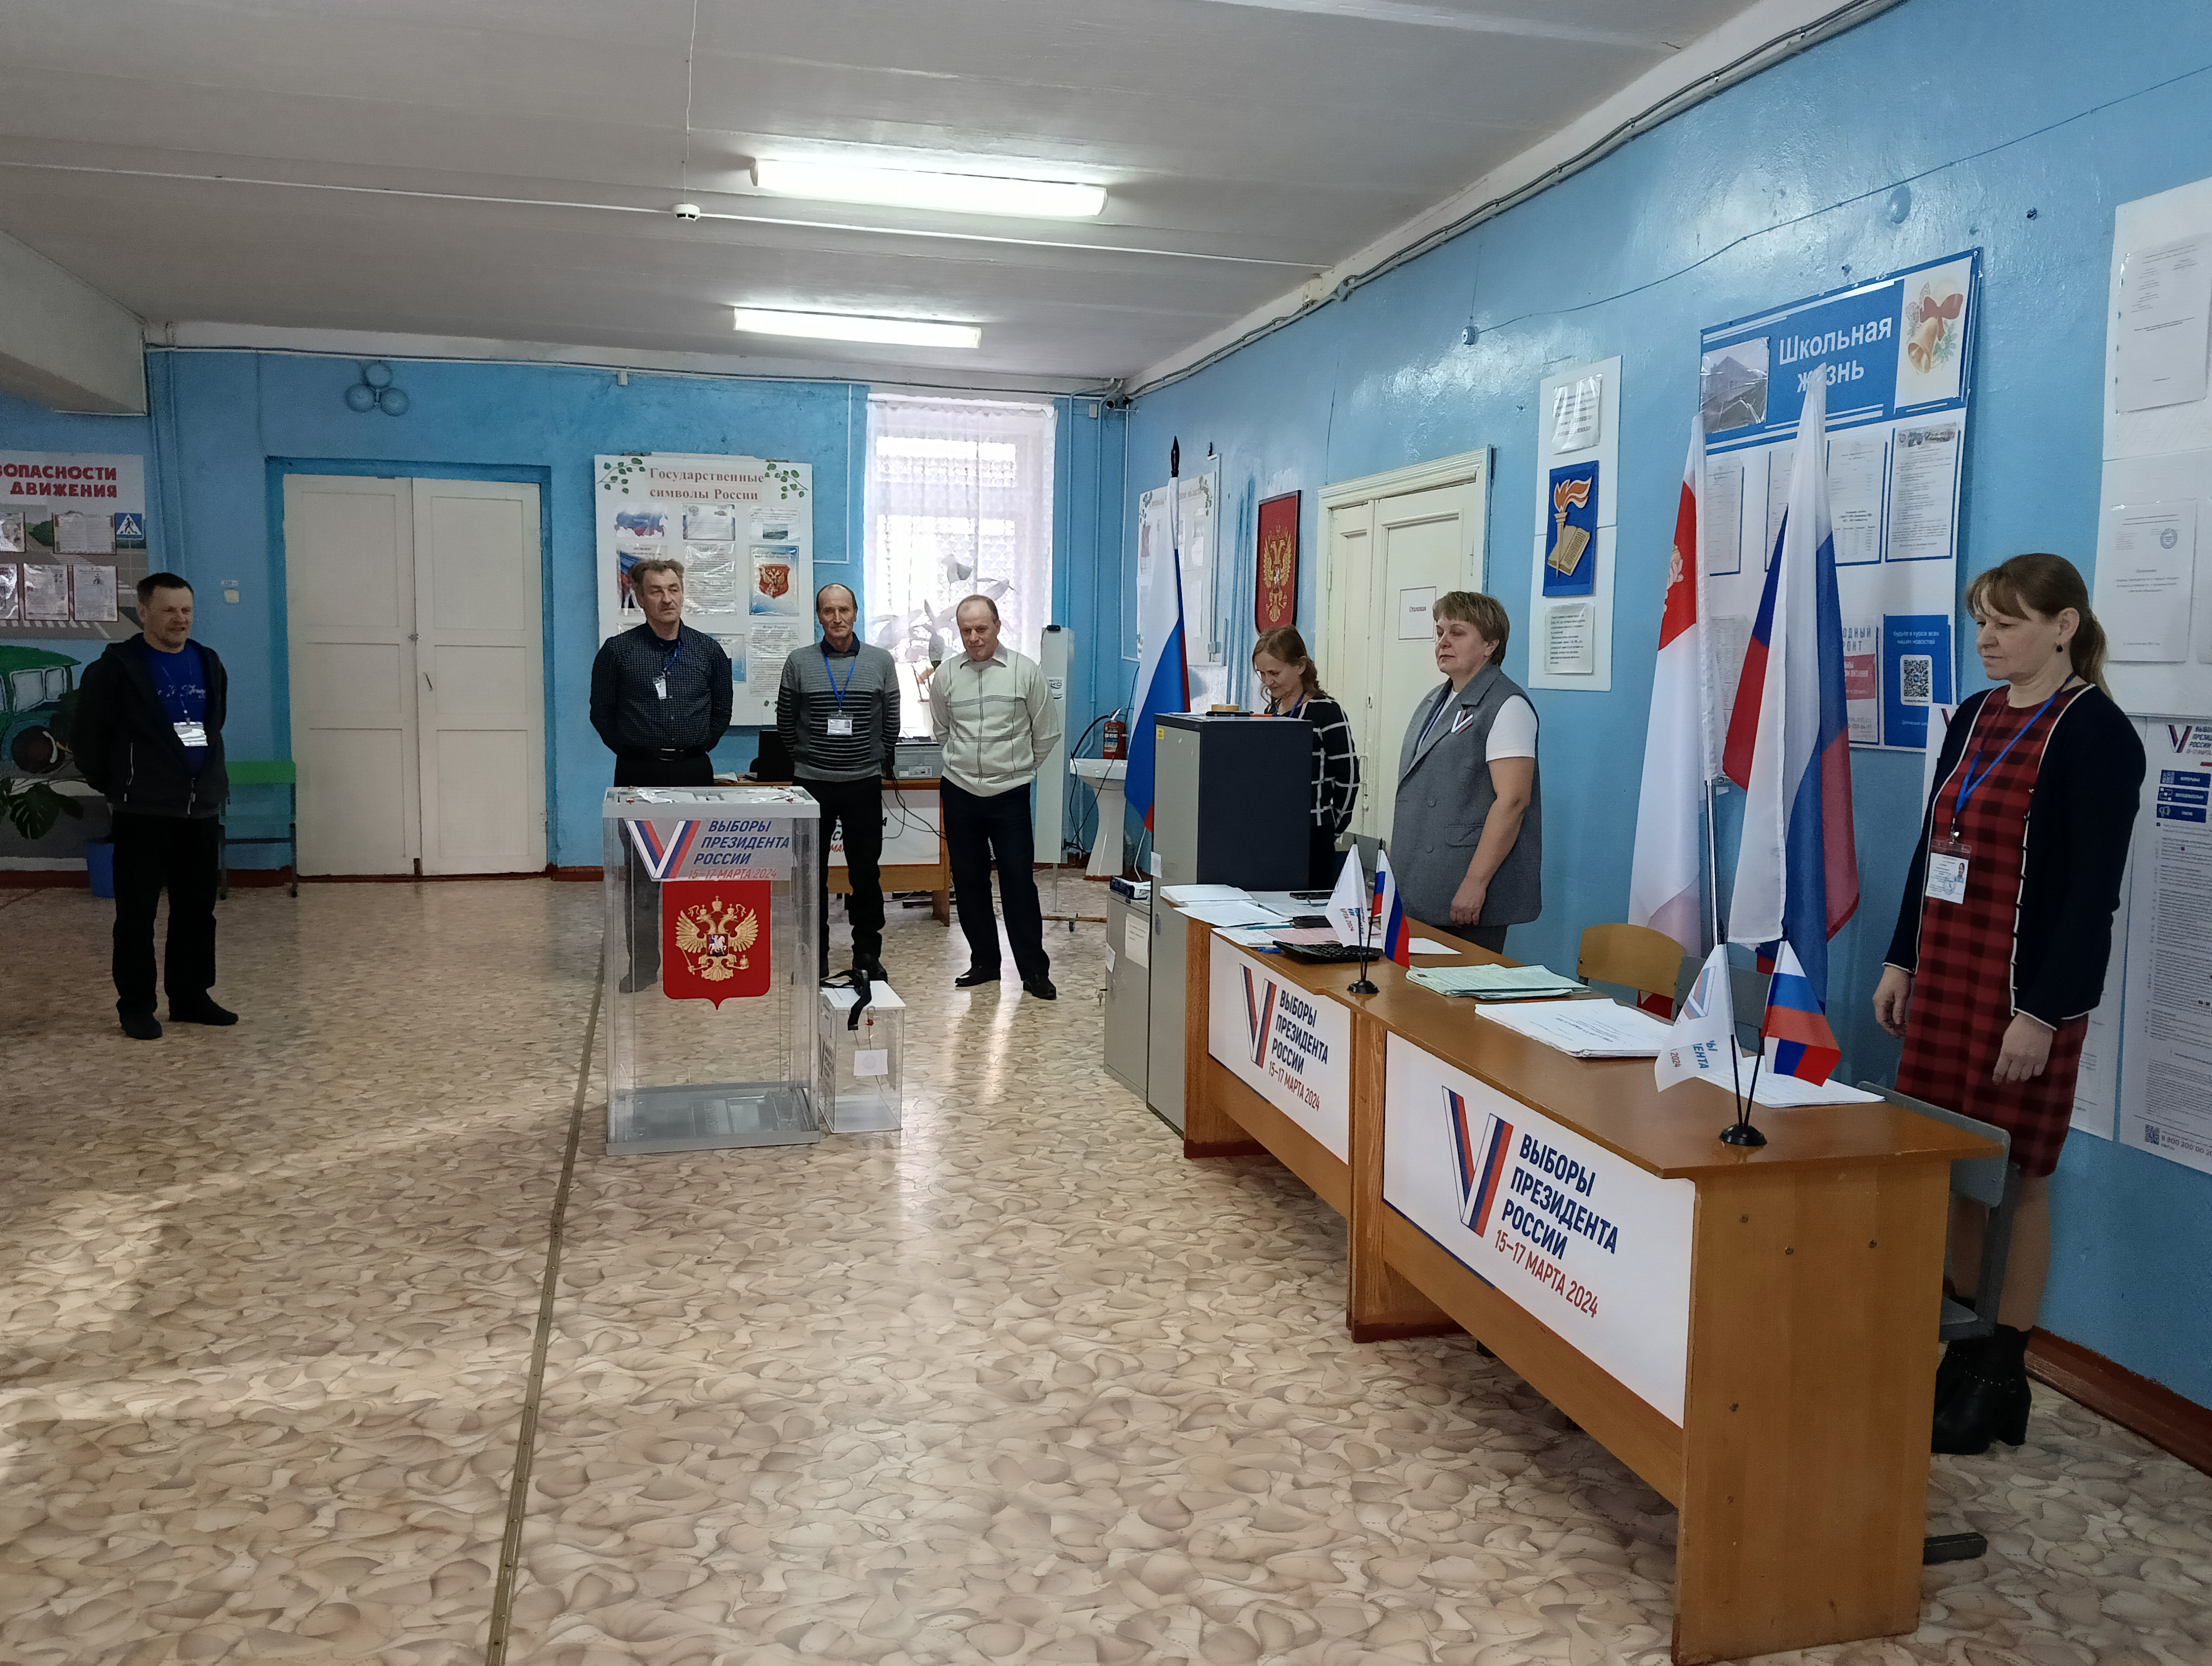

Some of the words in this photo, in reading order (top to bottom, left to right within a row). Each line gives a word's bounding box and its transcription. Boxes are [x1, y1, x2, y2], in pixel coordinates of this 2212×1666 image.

[1779, 317, 1892, 366] Школьная
[1797, 360, 1864, 393] жзнь
[0, 463, 117, 480] ОПАСНОСТИ
[650, 468, 764, 483] Государственные
[10, 482, 117, 498] ДВИЖЕНИЯ
[650, 489, 709, 499] символы
[715, 489, 758, 500] России
[1843, 625, 1871, 638] ОДНЫЙ
[708, 820, 772, 832] ВЫБОРЫ
[700, 836, 790, 850] ПРЕЗИДЕНТА
[693, 853, 752, 865] РОССИИ
[717, 868, 753, 879] МАРТА
[753, 868, 777, 879] 2024
[1279, 990, 1317, 1028] ВЫБОРЫ
[1275, 1014, 1328, 1064] ПРЕЗИДЕНТА
[1271, 1037, 1305, 1075] РОССИИ
[1670, 1052, 1681, 1067] 2024
[1284, 1072, 1304, 1100] МАРТА
[1304, 1087, 1320, 1112] 2024
[1519, 1133, 1596, 1197] ВЫБОРЫ
[1510, 1166, 1619, 1254] ПРЕЗИДЕНТА
[1501, 1199, 1568, 1260] РОССИИ
[1525, 1251, 1566, 1296] МАРТА
[1566, 1280, 1599, 1318] 2024
